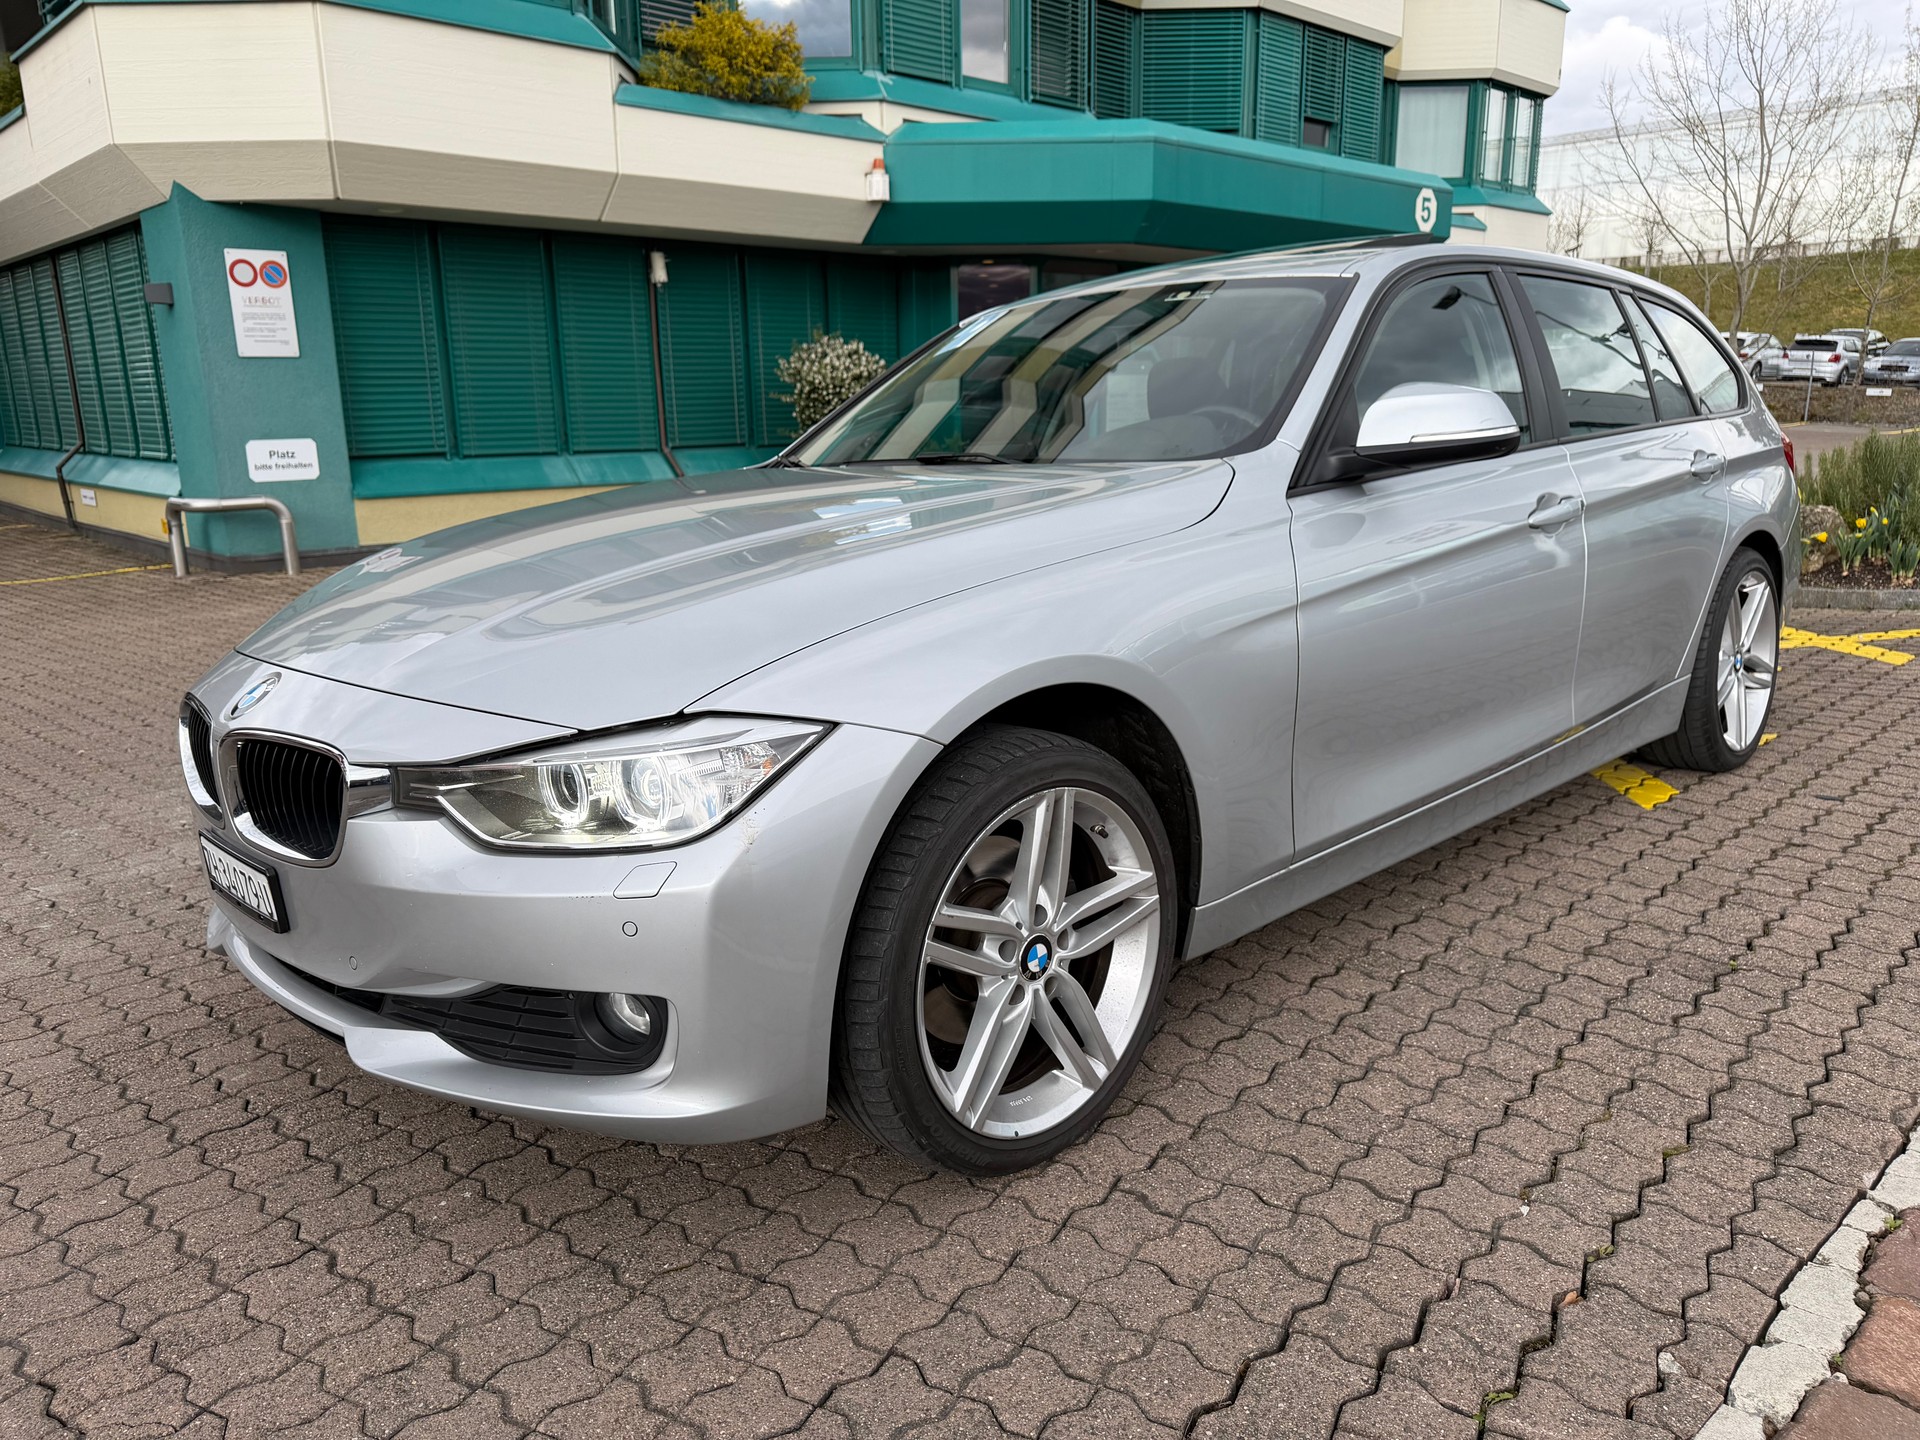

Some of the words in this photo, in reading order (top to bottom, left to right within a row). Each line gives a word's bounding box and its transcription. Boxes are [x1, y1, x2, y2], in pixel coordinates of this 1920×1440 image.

[1421, 197, 1432, 224] 5
[242, 296, 282, 306] VERBOT
[268, 449, 296, 459] Platz
[254, 463, 274, 471] bitte
[274, 462, 314, 471] freihalten
